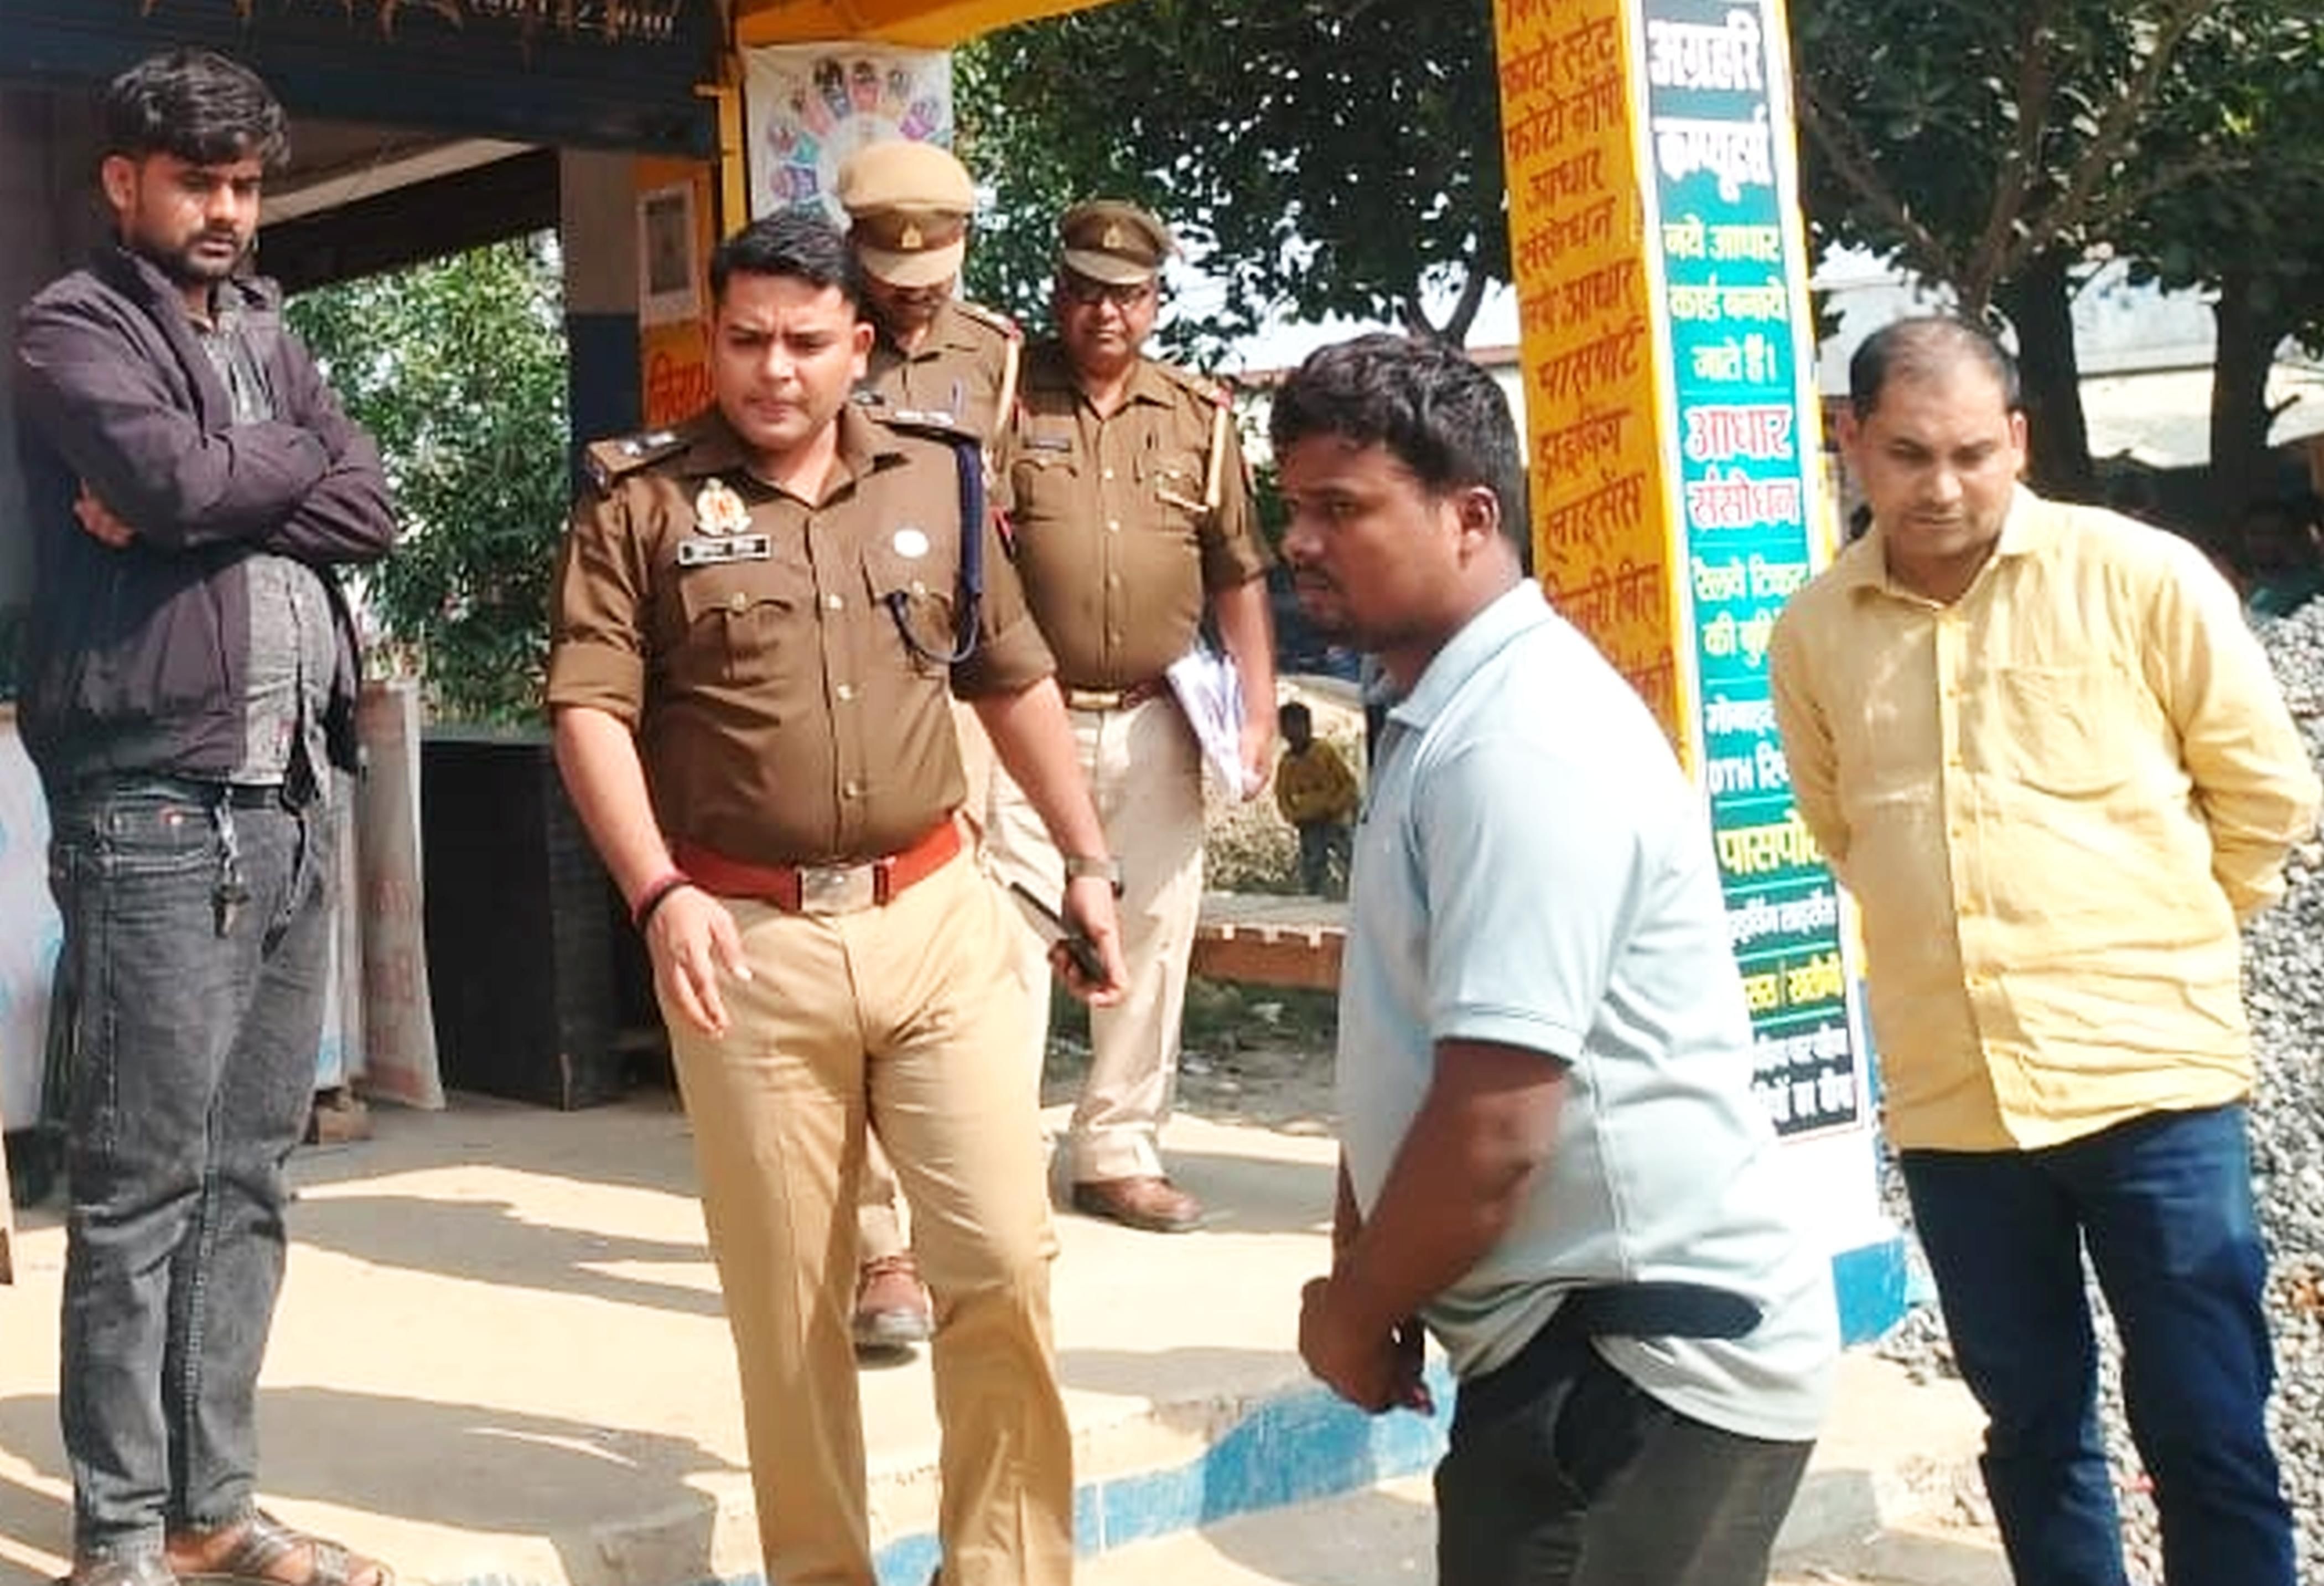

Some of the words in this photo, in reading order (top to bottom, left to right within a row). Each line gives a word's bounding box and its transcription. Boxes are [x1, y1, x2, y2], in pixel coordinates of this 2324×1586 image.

[1500, 31, 1558, 102] फोटो
[1506, 89, 1569, 160] फोटो
[1525, 148, 1605, 212] आधार
[1709, 226, 1781, 263] आधार
[1561, 257, 1637, 324] आधार
[1537, 315, 1645, 404] पासपोर्ट
[1685, 405, 1792, 461] आधार
